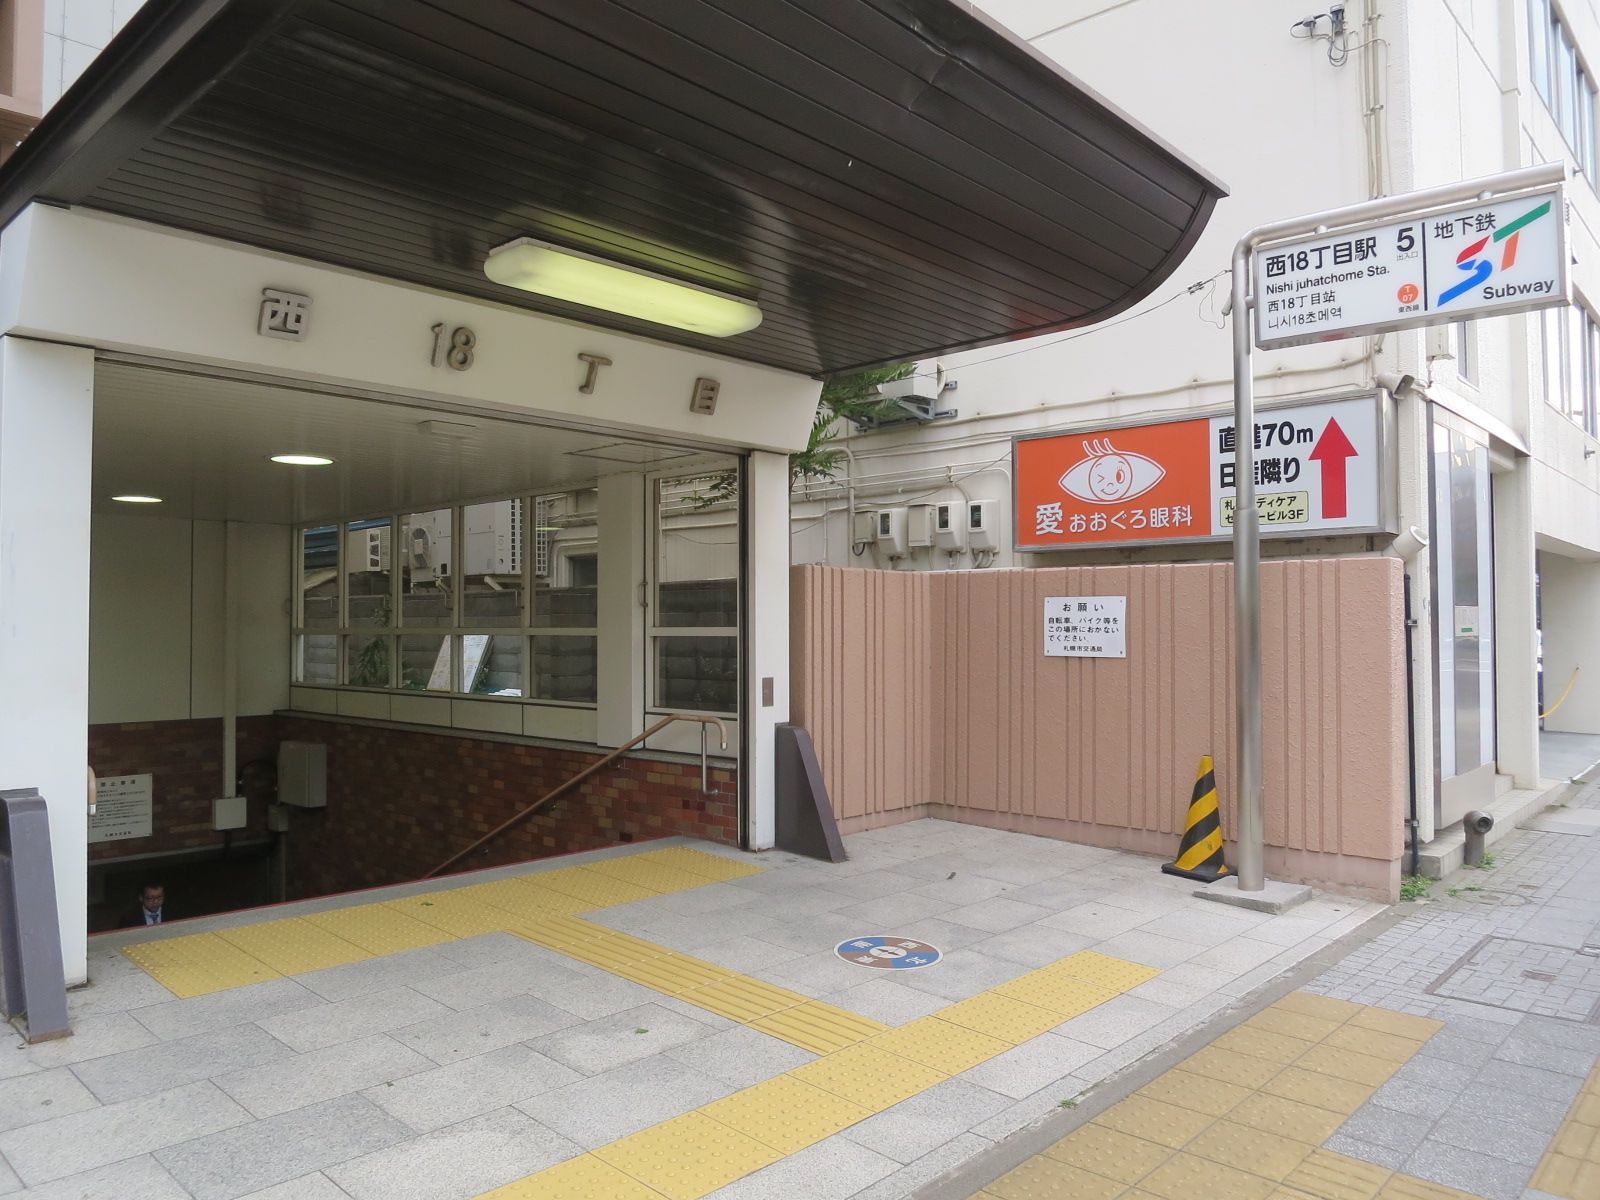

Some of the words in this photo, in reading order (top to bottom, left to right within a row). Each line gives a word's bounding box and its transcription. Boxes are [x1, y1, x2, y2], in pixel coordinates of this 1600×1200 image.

[1434, 212, 1496, 239] 地下鉄
[1397, 227, 1415, 252] 5
[1266, 236, 1377, 277] 西18丁目駅
[1396, 251, 1418, 261] 出入口
[1266, 281, 1293, 295] Nishi
[1296, 269, 1363, 292] juhatchome
[1367, 265, 1390, 277] Sta.
[1483, 279, 1554, 300] Subway
[1268, 290, 1336, 313] 西18丁目站
[1402, 293, 1414, 302] 07
[1268, 306, 1342, 329] 니시18초메역
[1220, 457, 1300, 488] 日隣り
[1225, 495, 1297, 511] 札ディケア
[1225, 509, 1304, 524] セービル3F
[1062, 602, 1104, 612] お願い
[1048, 625, 1119, 634] この場所におかない
